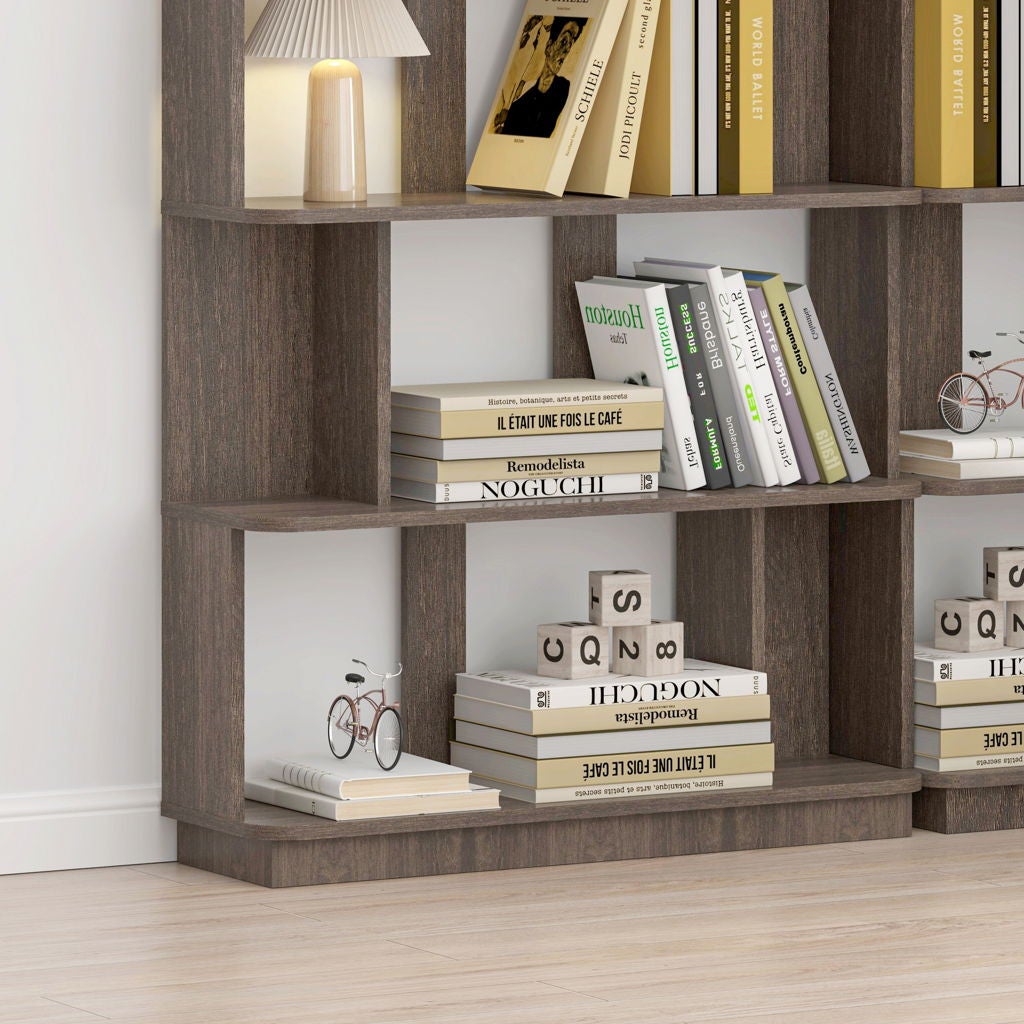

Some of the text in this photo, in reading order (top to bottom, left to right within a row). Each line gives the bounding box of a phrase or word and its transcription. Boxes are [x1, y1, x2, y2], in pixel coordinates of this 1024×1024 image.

[638, 14, 649, 49] second
[752, 17, 763, 120] WORLD BALLET
[574, 58, 604, 123] SCHIELE
[618, 71, 642, 160] JODI PICOULT
[488, 398, 518, 406] Histoire,
[520, 396, 555, 405] botanique,
[581, 394, 601, 402] petits
[497, 408, 623, 430] IL ÉTAIT UNE FOIS LE CAFÉ
[507, 458, 585, 473] Remodelista
[480, 476, 605, 499] NOGUCHI
[612, 589, 642, 613] S
[940, 611, 962, 637] C
[977, 609, 997, 639] Q
[543, 635, 677, 666] C Q 2 8
[589, 678, 721, 706] NOGUCHI
[614, 708, 698, 725] Remodelista
[582, 754, 716, 782] IL ÉTAIT UNE FOIS LE CAFÉ
